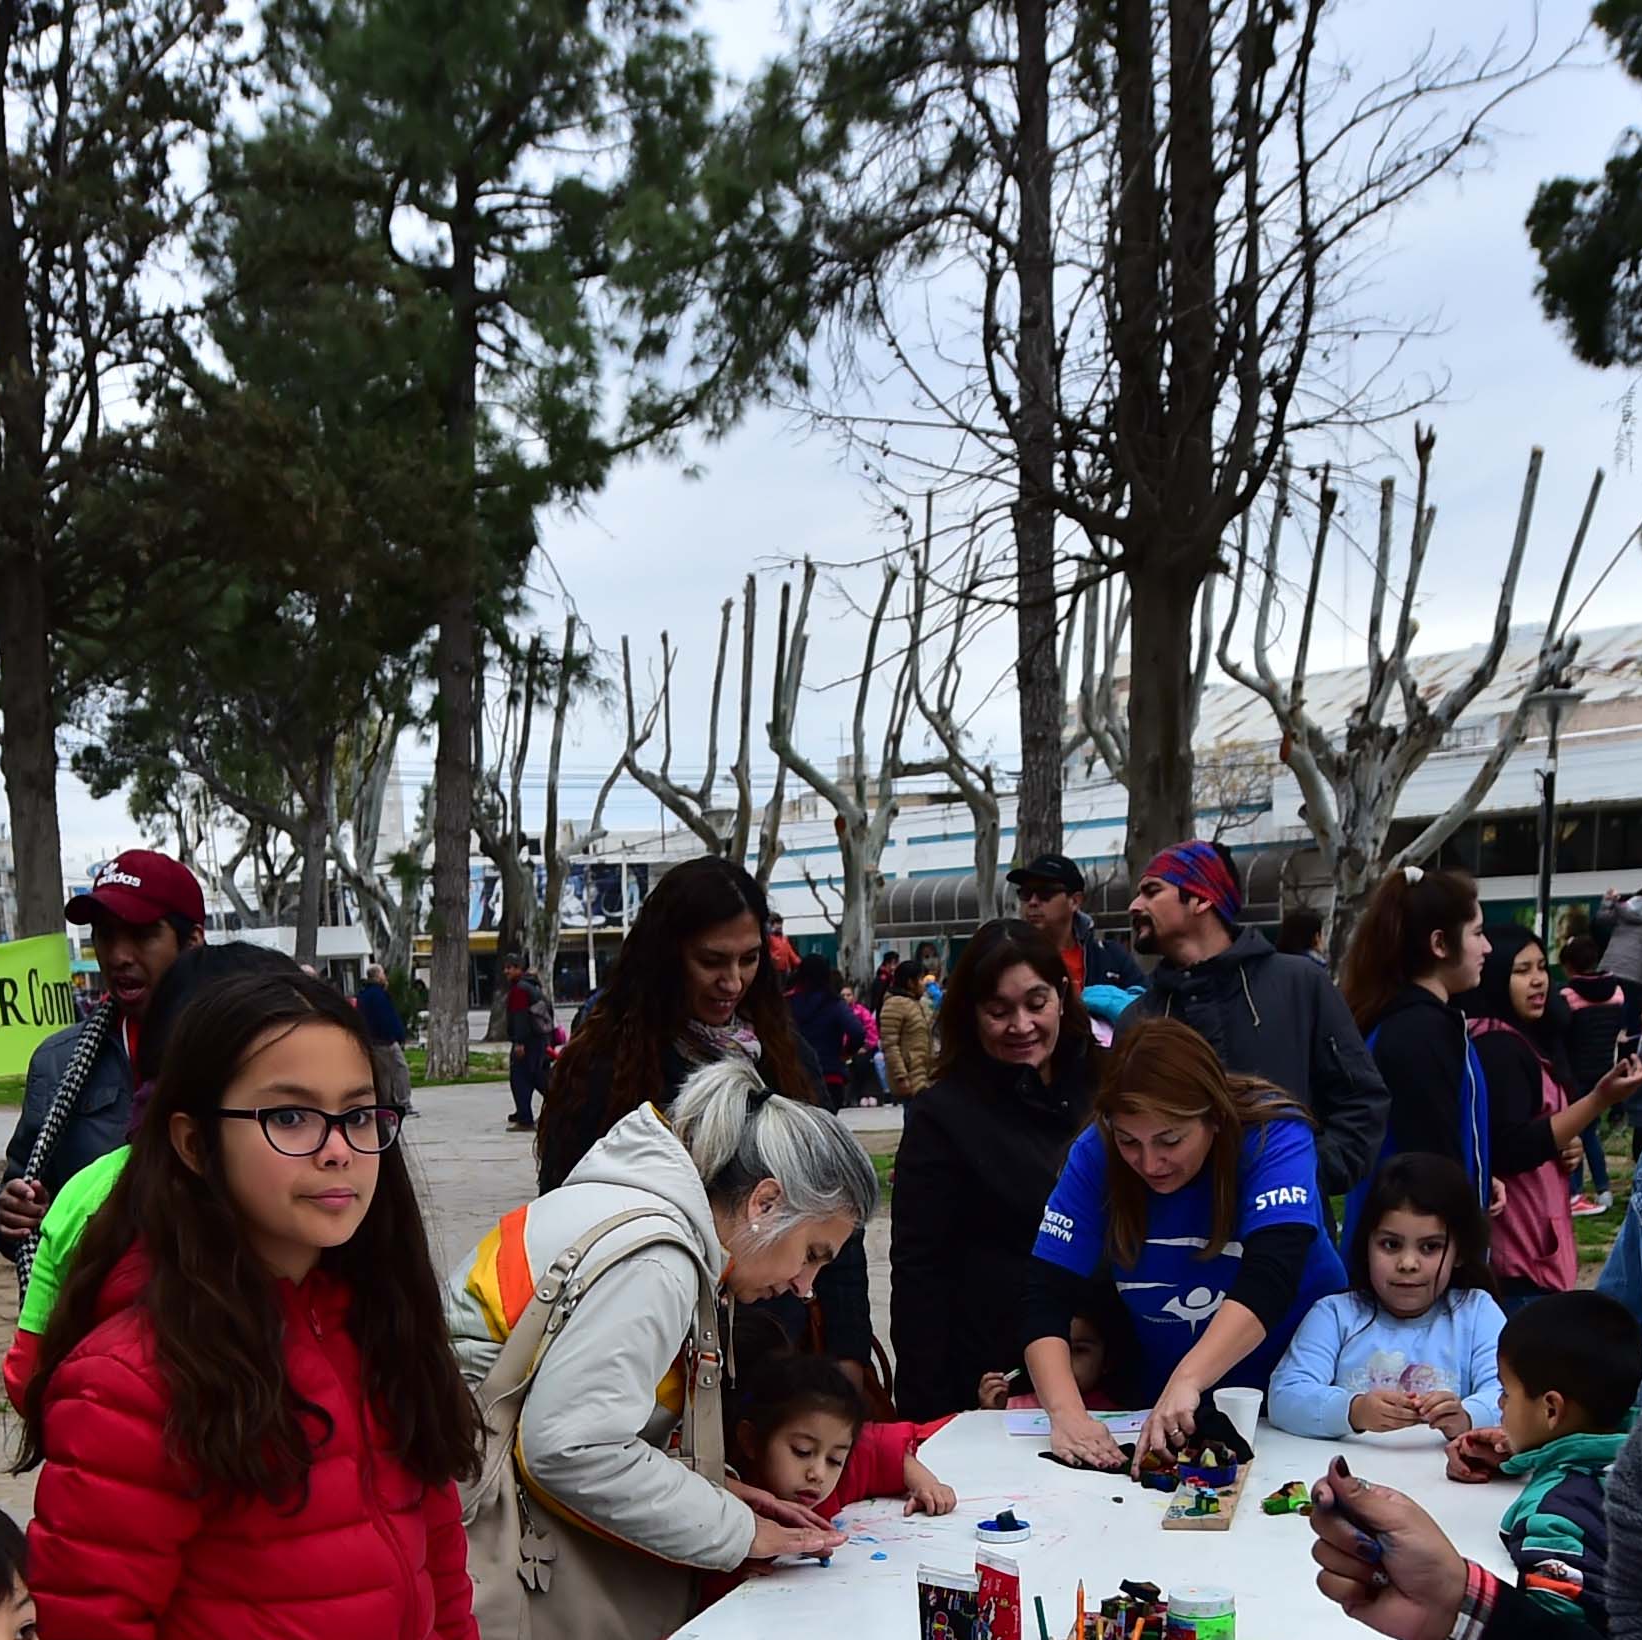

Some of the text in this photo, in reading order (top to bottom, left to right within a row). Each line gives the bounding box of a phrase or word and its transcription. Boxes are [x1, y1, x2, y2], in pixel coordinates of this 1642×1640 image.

[97, 871, 141, 887] adidas
[27, 967, 74, 1027] Com
[1255, 1186, 1308, 1210] STAFF
